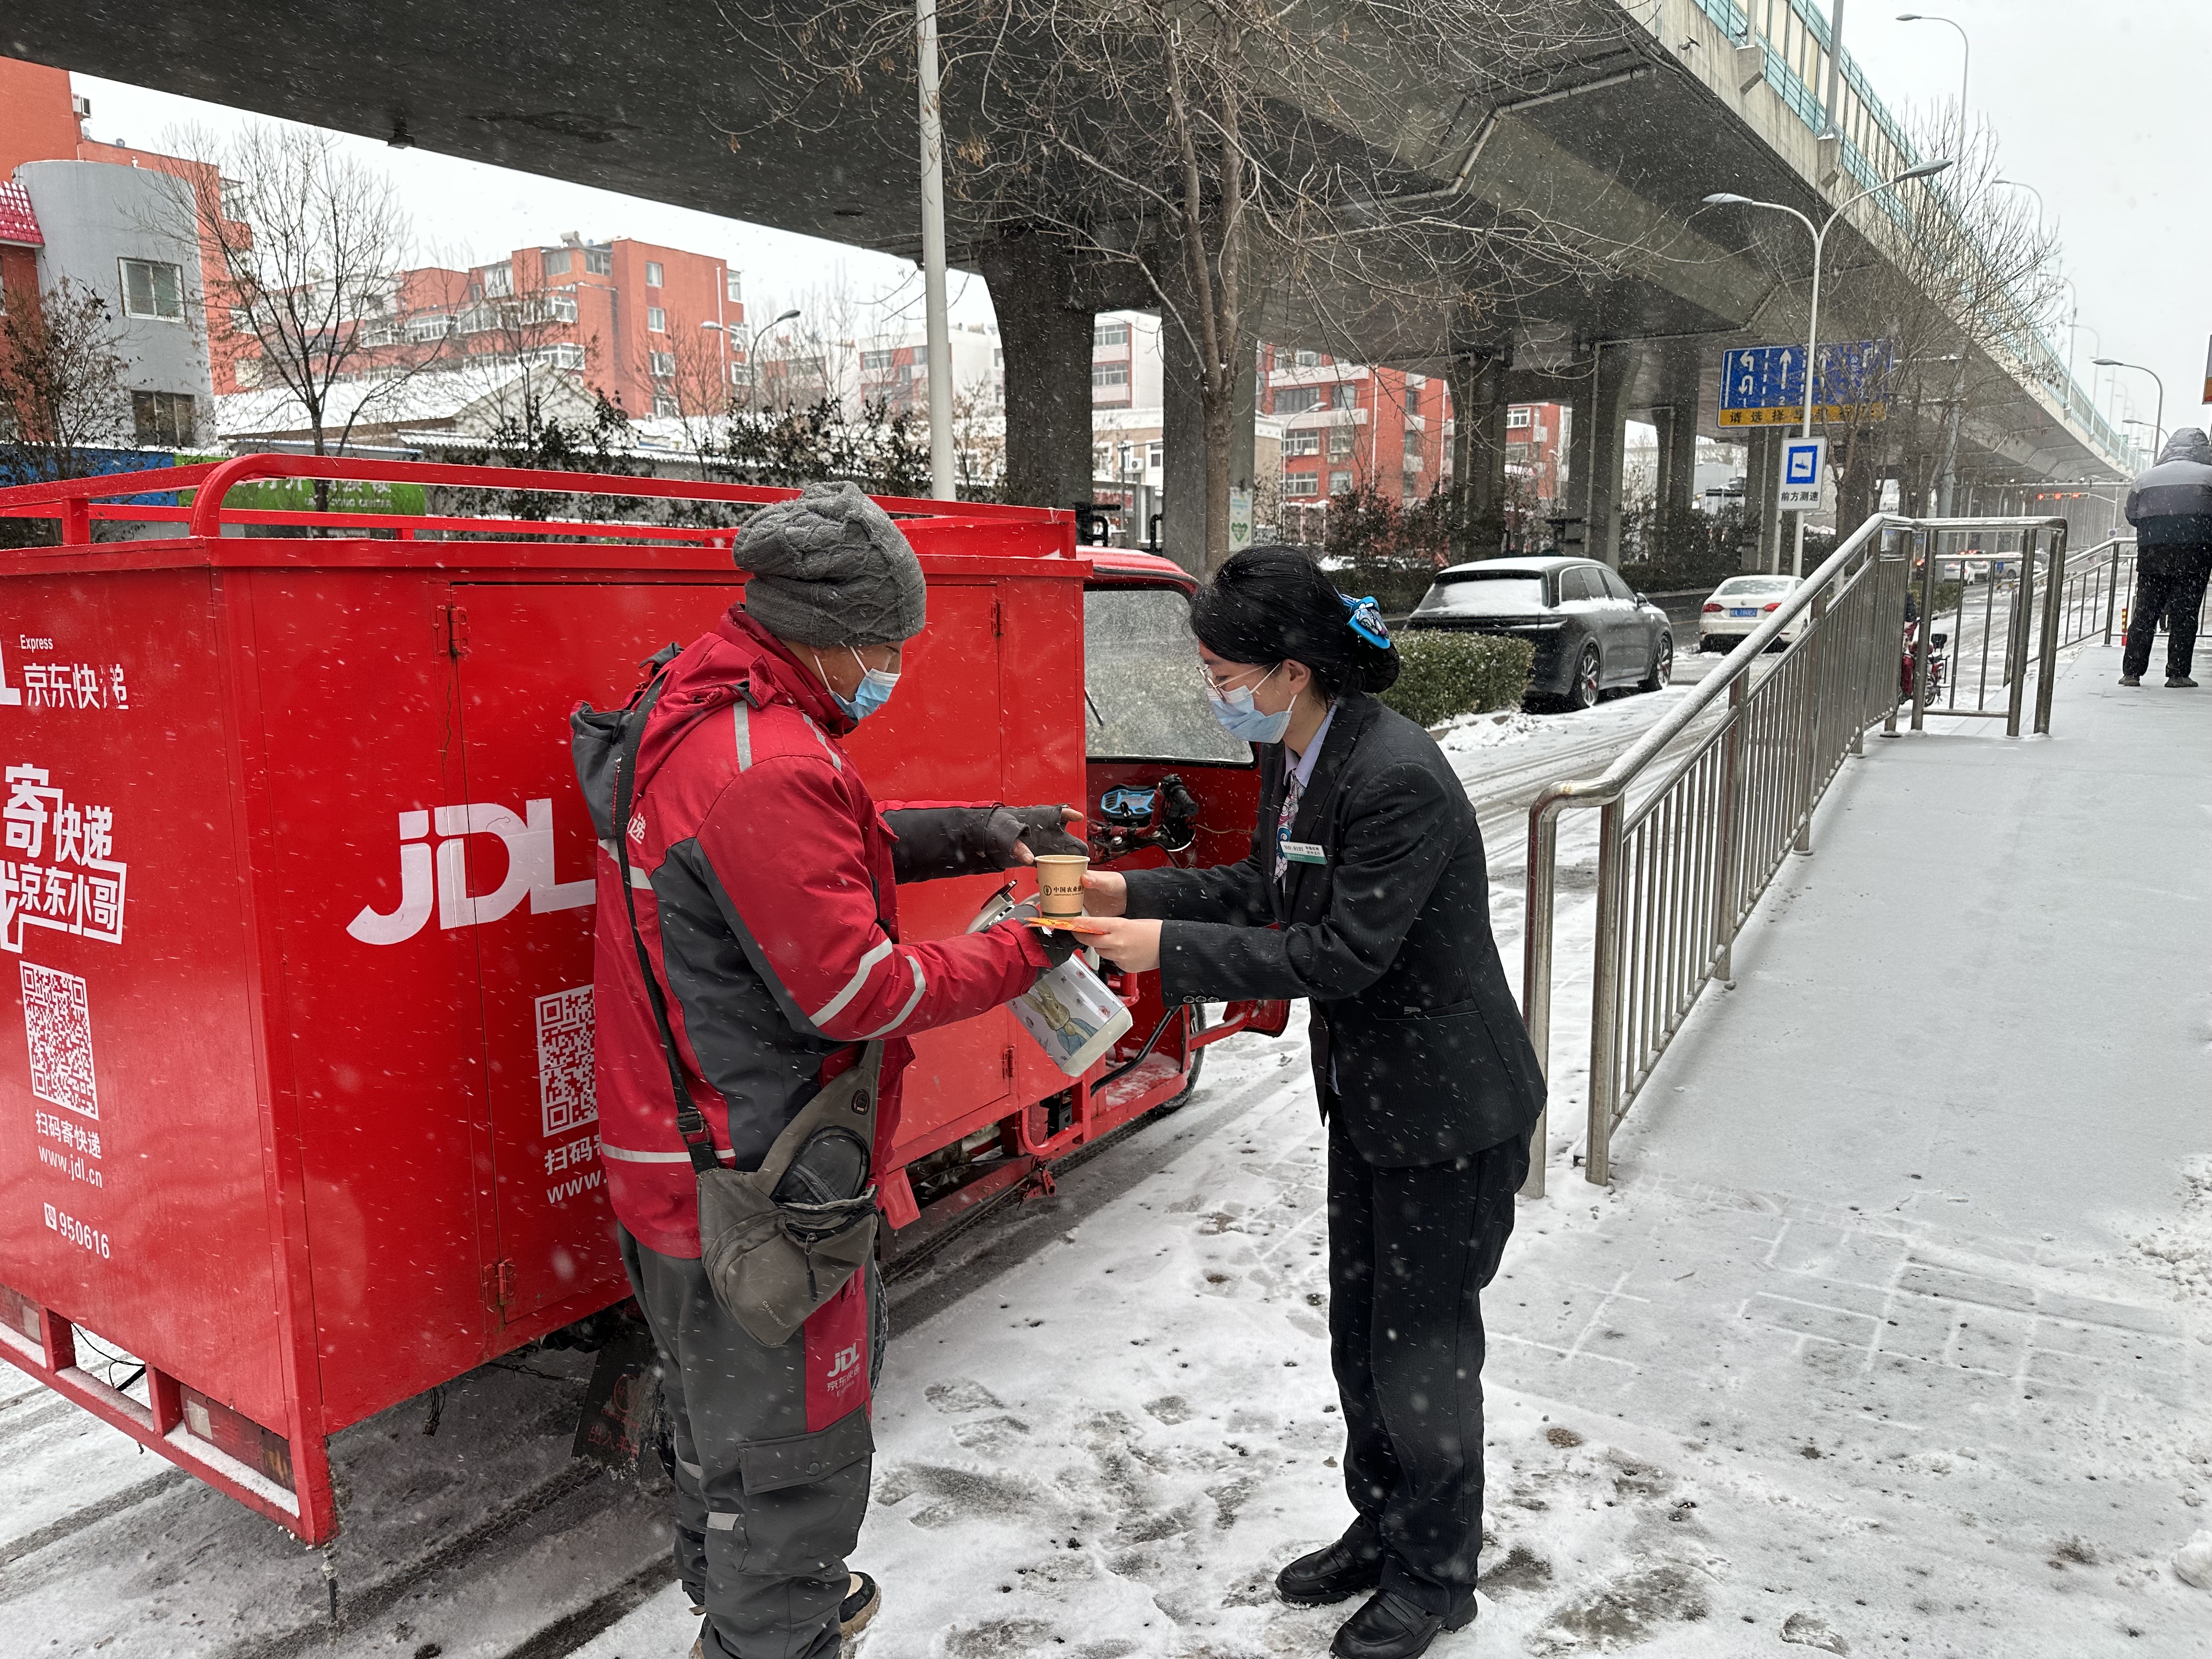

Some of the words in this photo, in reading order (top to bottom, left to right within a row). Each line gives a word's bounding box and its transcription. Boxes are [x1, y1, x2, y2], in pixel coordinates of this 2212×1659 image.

[1781, 490, 1819, 502] 前方测速
[20, 634, 53, 653] Express
[23, 663, 129, 710] 京东快递
[346, 798, 597, 945] JDL
[36, 1109, 101, 1159] 扫码寄快递
[544, 1134, 600, 1176] 扫码
[38, 1145, 103, 1188] www.jdl.cn
[59, 1212, 110, 1259] 950616
[827, 1341, 860, 1378] JDL
